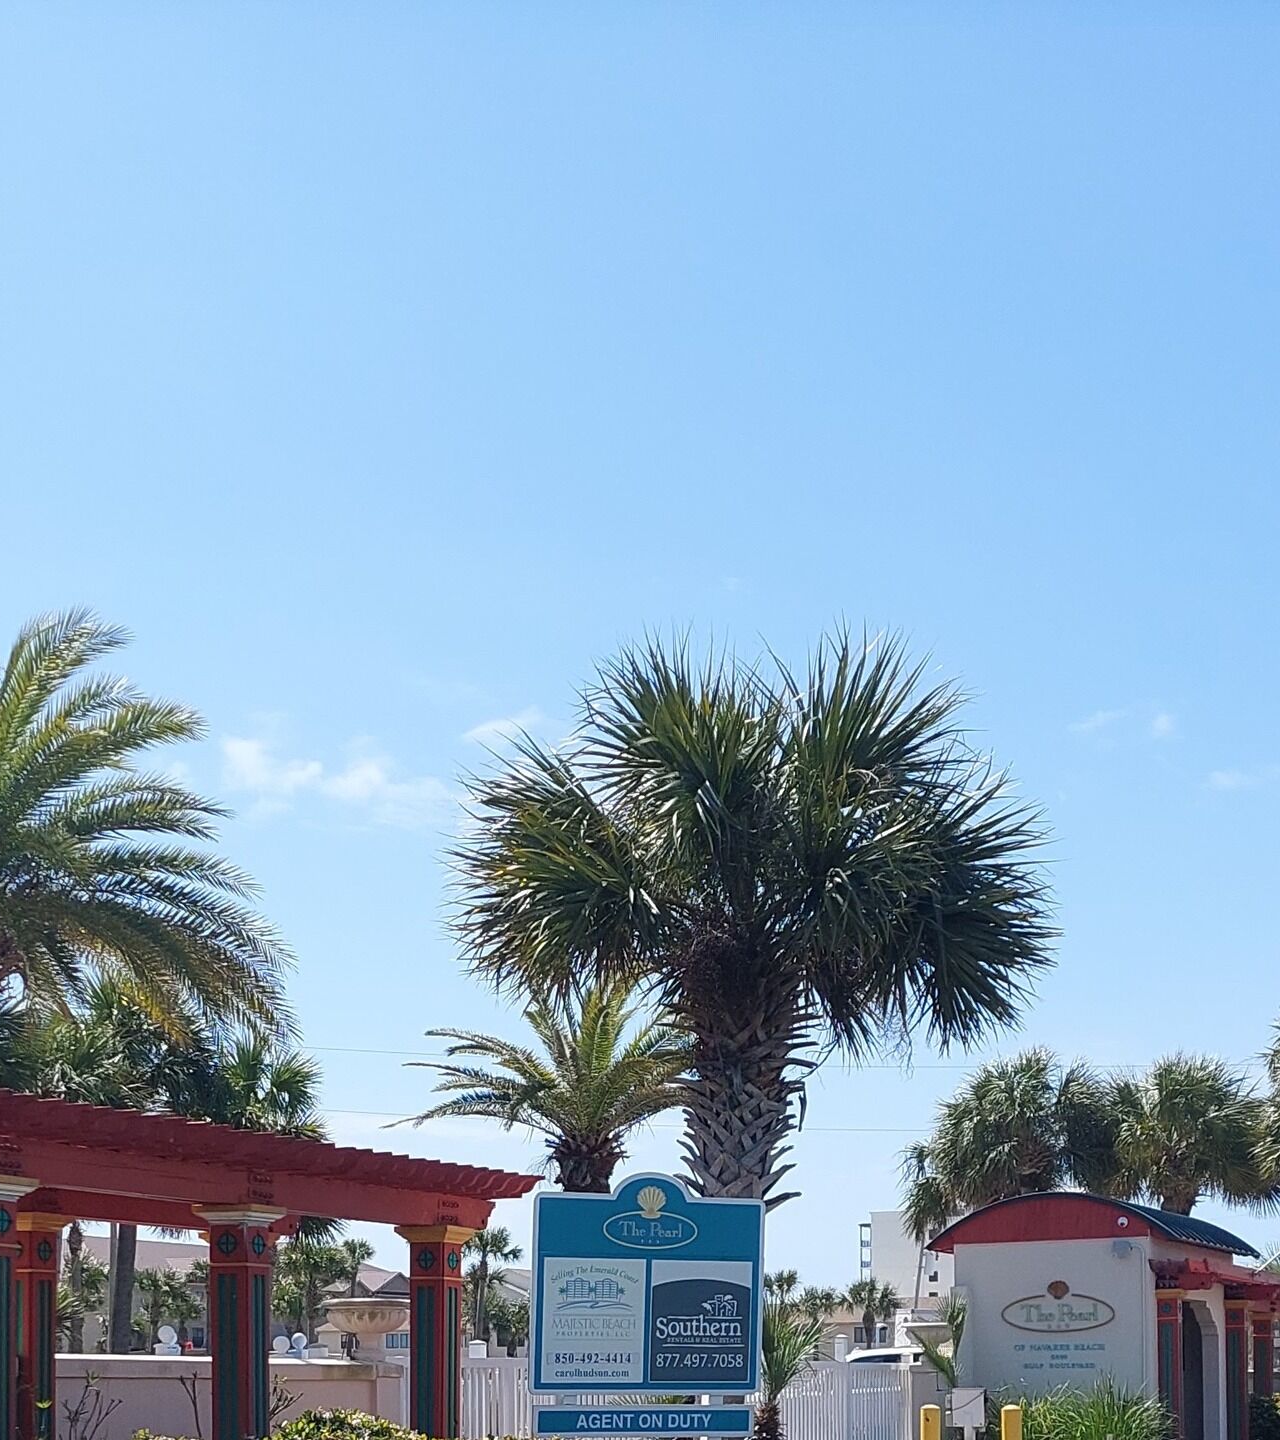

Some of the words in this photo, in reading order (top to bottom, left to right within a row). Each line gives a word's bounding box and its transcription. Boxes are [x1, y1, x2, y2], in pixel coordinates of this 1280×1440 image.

[619, 1221, 646, 1236] The
[650, 1222, 682, 1238] Pearl
[551, 1269, 574, 1284] Selling
[576, 1266, 588, 1275] The
[590, 1265, 619, 1276] Emerald
[620, 1270, 639, 1284] Coast
[1021, 1304, 1055, 1322] The
[1057, 1304, 1099, 1322] Pearl
[552, 1318, 600, 1330] MAJESTIC
[603, 1318, 636, 1329] BEACH
[656, 1314, 742, 1339] Southern
[554, 1352, 632, 1364] 850-492-4414
[656, 1353, 744, 1368] 877.497.7058
[554, 1367, 630, 1378] carolhudson.com
[576, 1413, 635, 1429] AGENT
[638, 1413, 662, 1428] ON
[668, 1413, 712, 1428] DUTY
